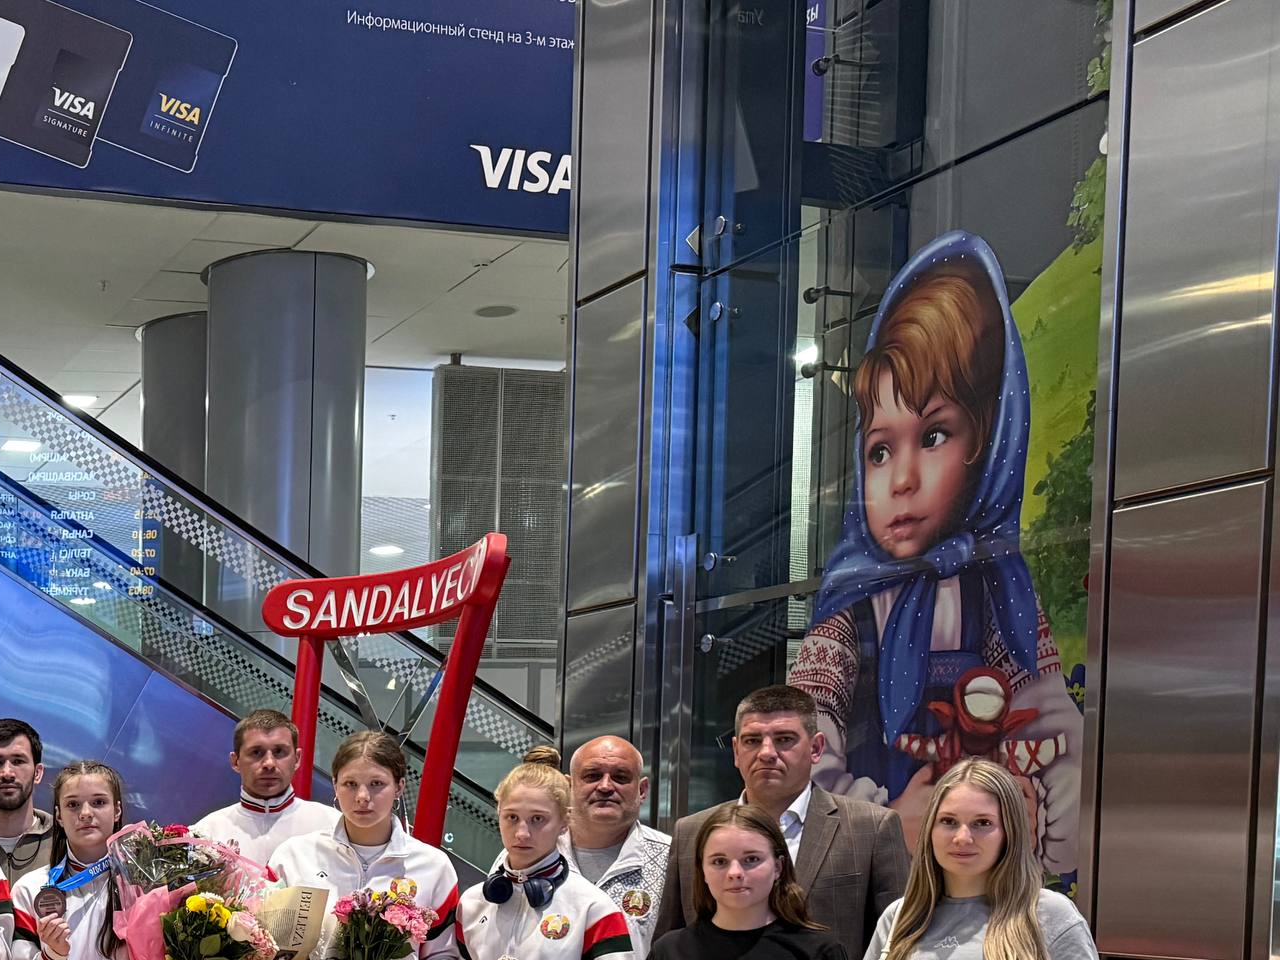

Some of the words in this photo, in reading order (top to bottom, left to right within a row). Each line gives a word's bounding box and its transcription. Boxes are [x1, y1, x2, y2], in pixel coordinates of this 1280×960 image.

[346, 9, 465, 38] Информационный
[468, 26, 504, 44] стенд
[507, 32, 522, 44] на
[525, 31, 546, 47] 3-м
[548, 37, 574, 50] этаж
[51, 86, 96, 120] VISA
[158, 92, 201, 126] VISA
[42, 115, 89, 138] SIGNATURE
[149, 120, 195, 144] INFINITE
[469, 144, 572, 194] VISA
[291, 890, 313, 947] BELLEZA
